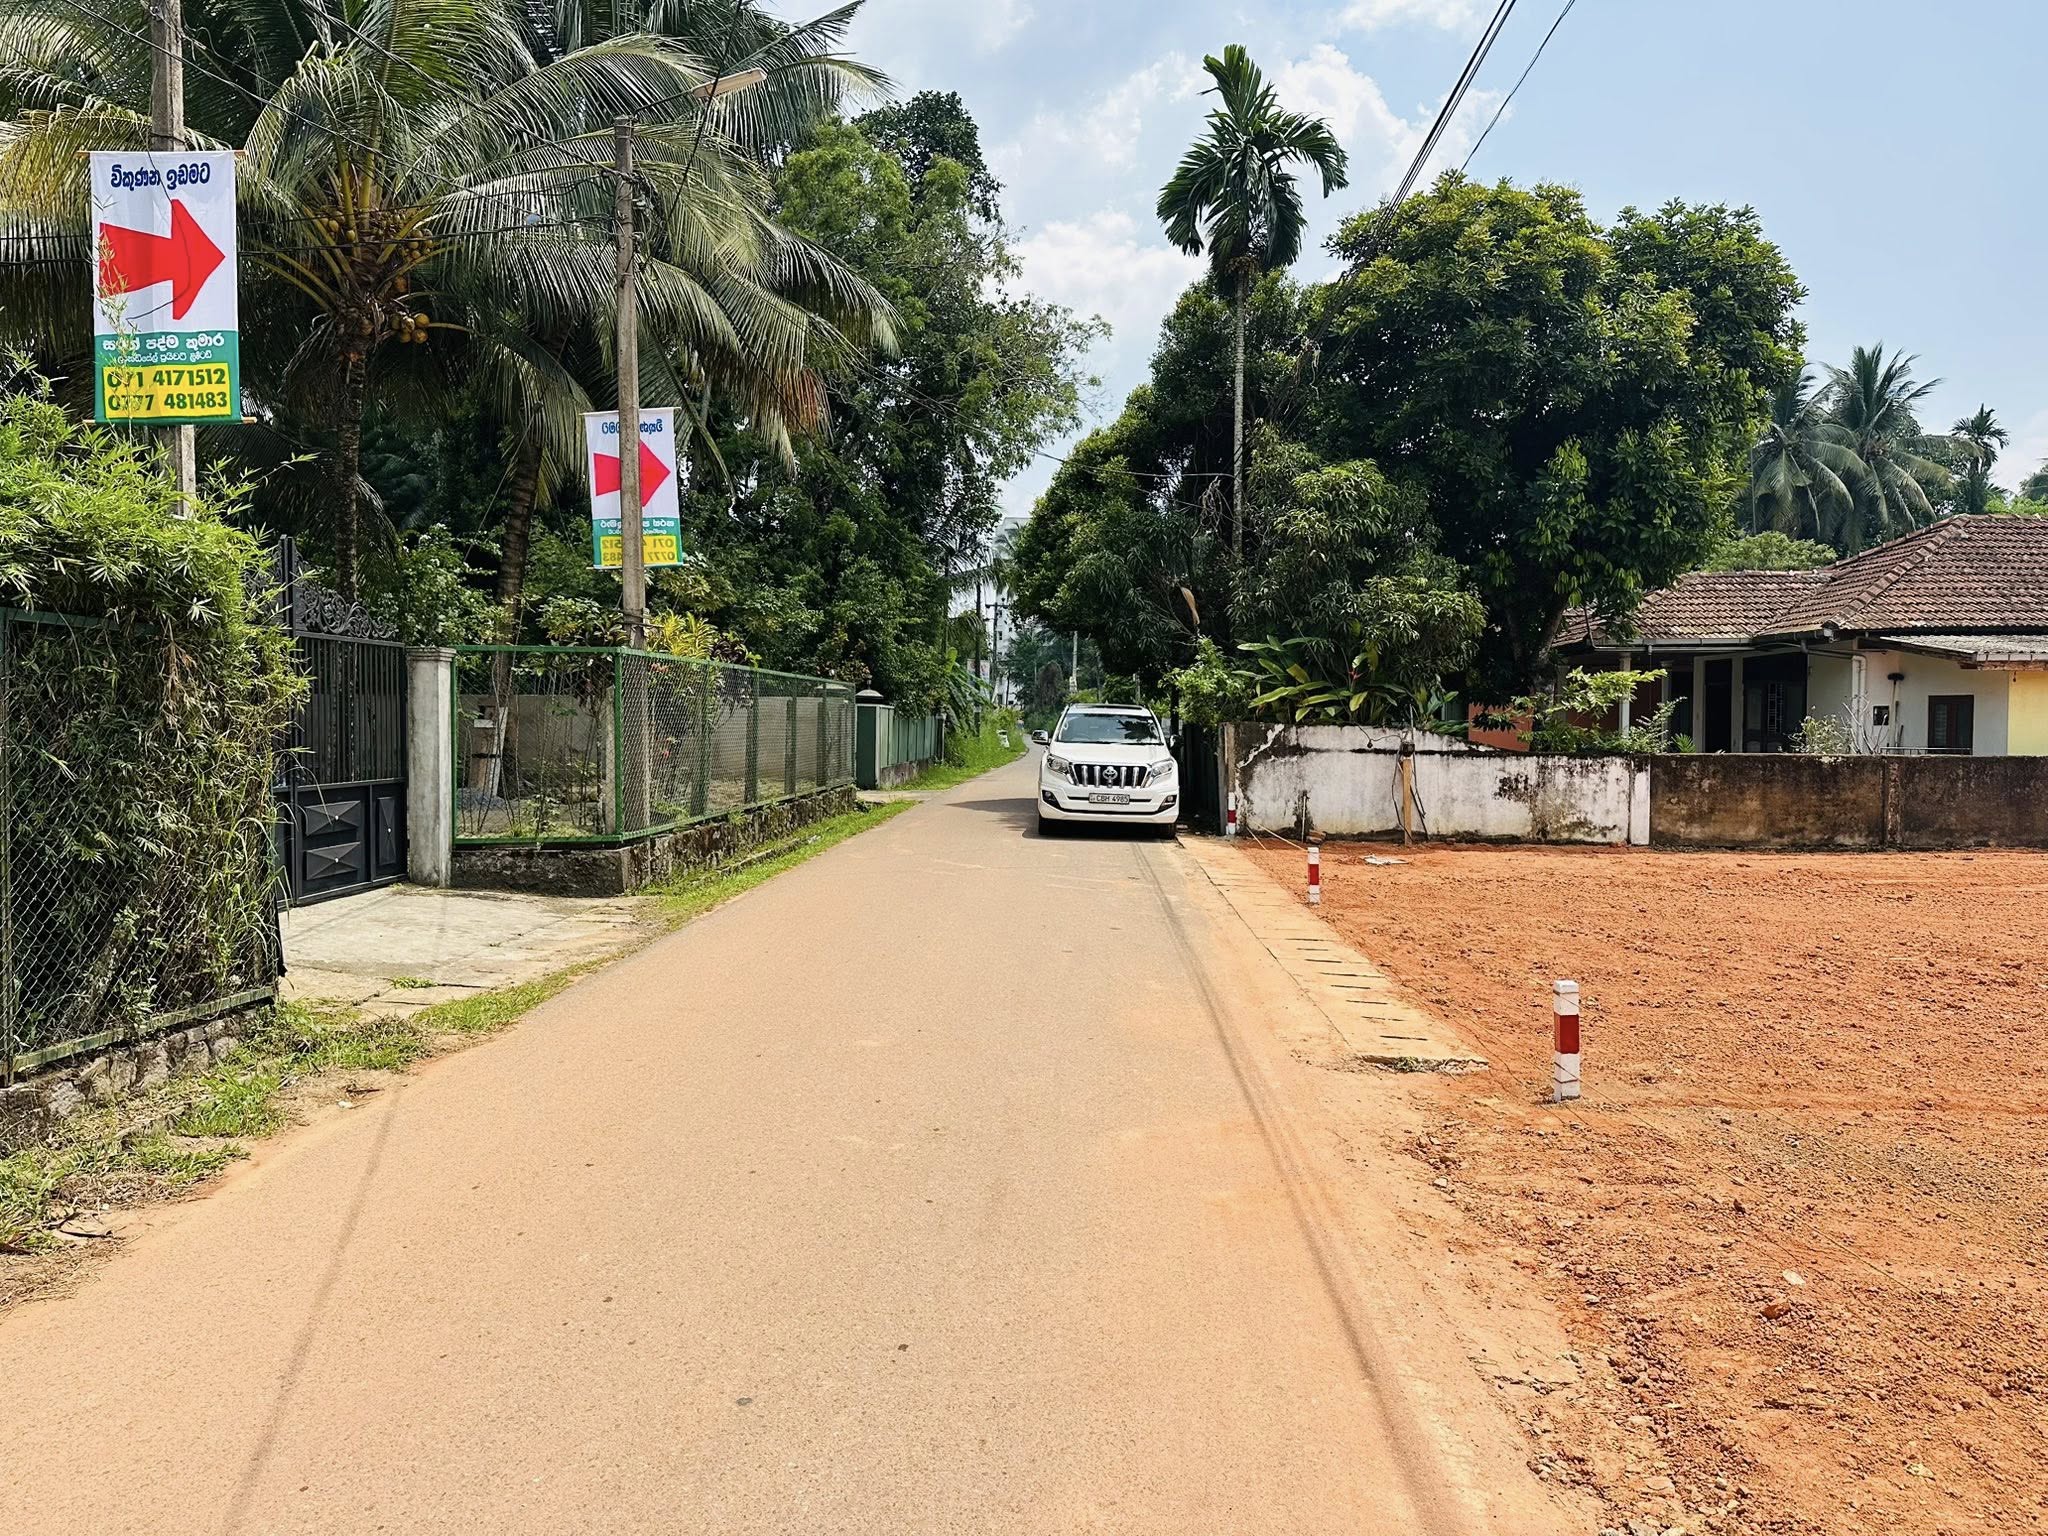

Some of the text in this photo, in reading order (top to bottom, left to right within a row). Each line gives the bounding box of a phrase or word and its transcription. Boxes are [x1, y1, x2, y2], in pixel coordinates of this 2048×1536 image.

[110, 162, 211, 191] විකුණන ඉඩමට
[185, 332, 225, 350] කුමාර
[152, 368, 226, 387] 4171512
[164, 391, 227, 410] 481483
